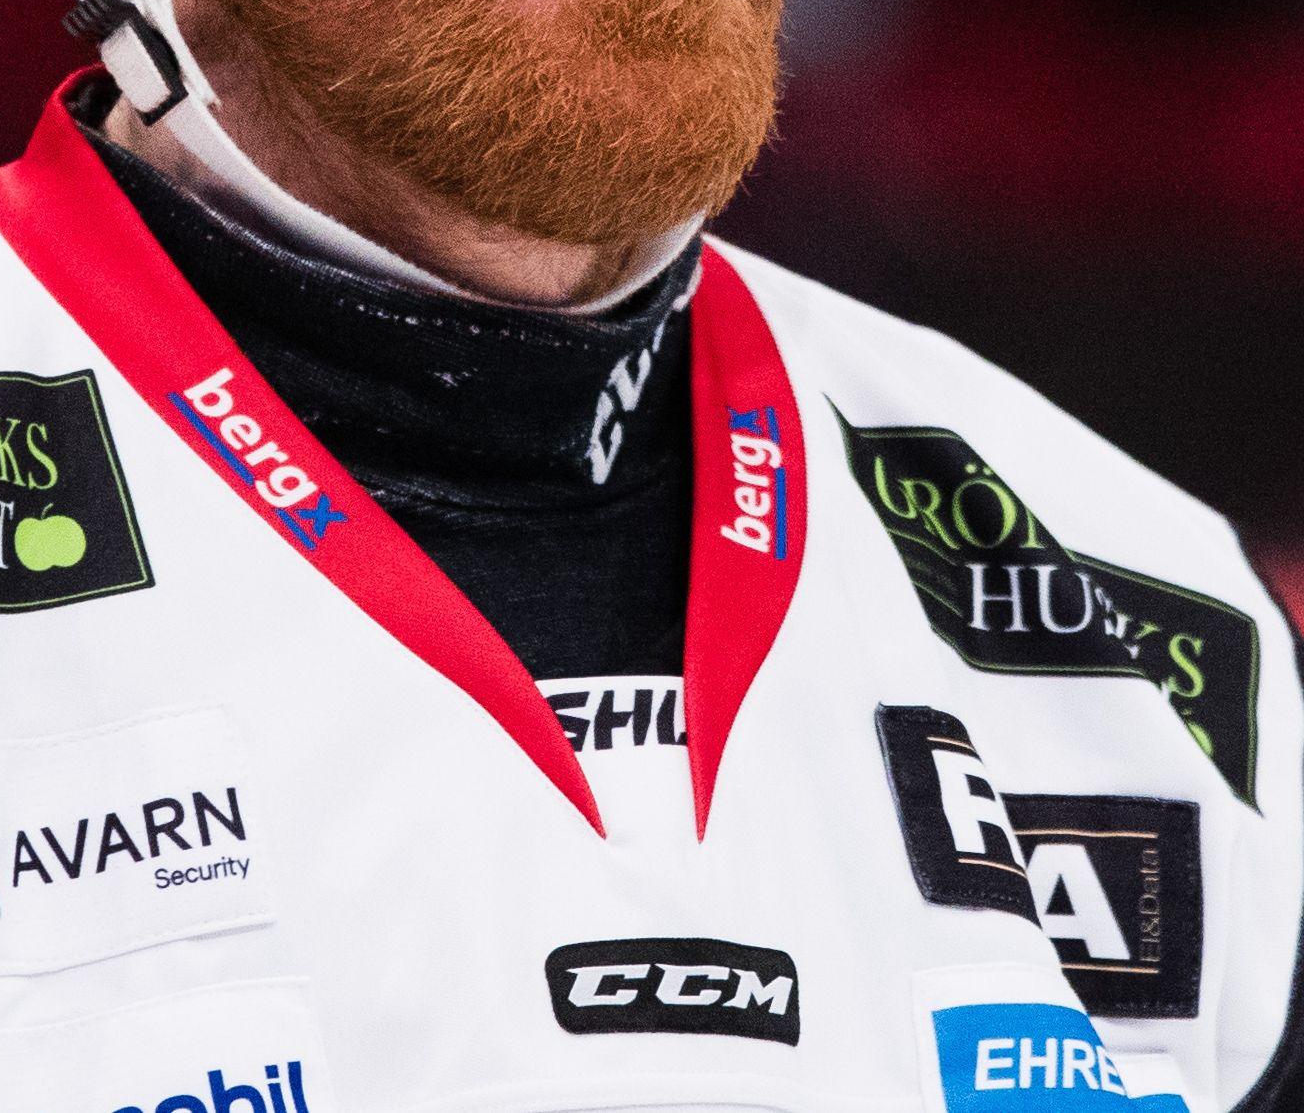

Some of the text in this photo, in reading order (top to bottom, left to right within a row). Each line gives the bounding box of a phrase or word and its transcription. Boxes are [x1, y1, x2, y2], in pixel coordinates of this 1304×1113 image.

[13, 787, 247, 888] AVARN
[154, 854, 251, 890] Security
[565, 963, 794, 1016] CCM
